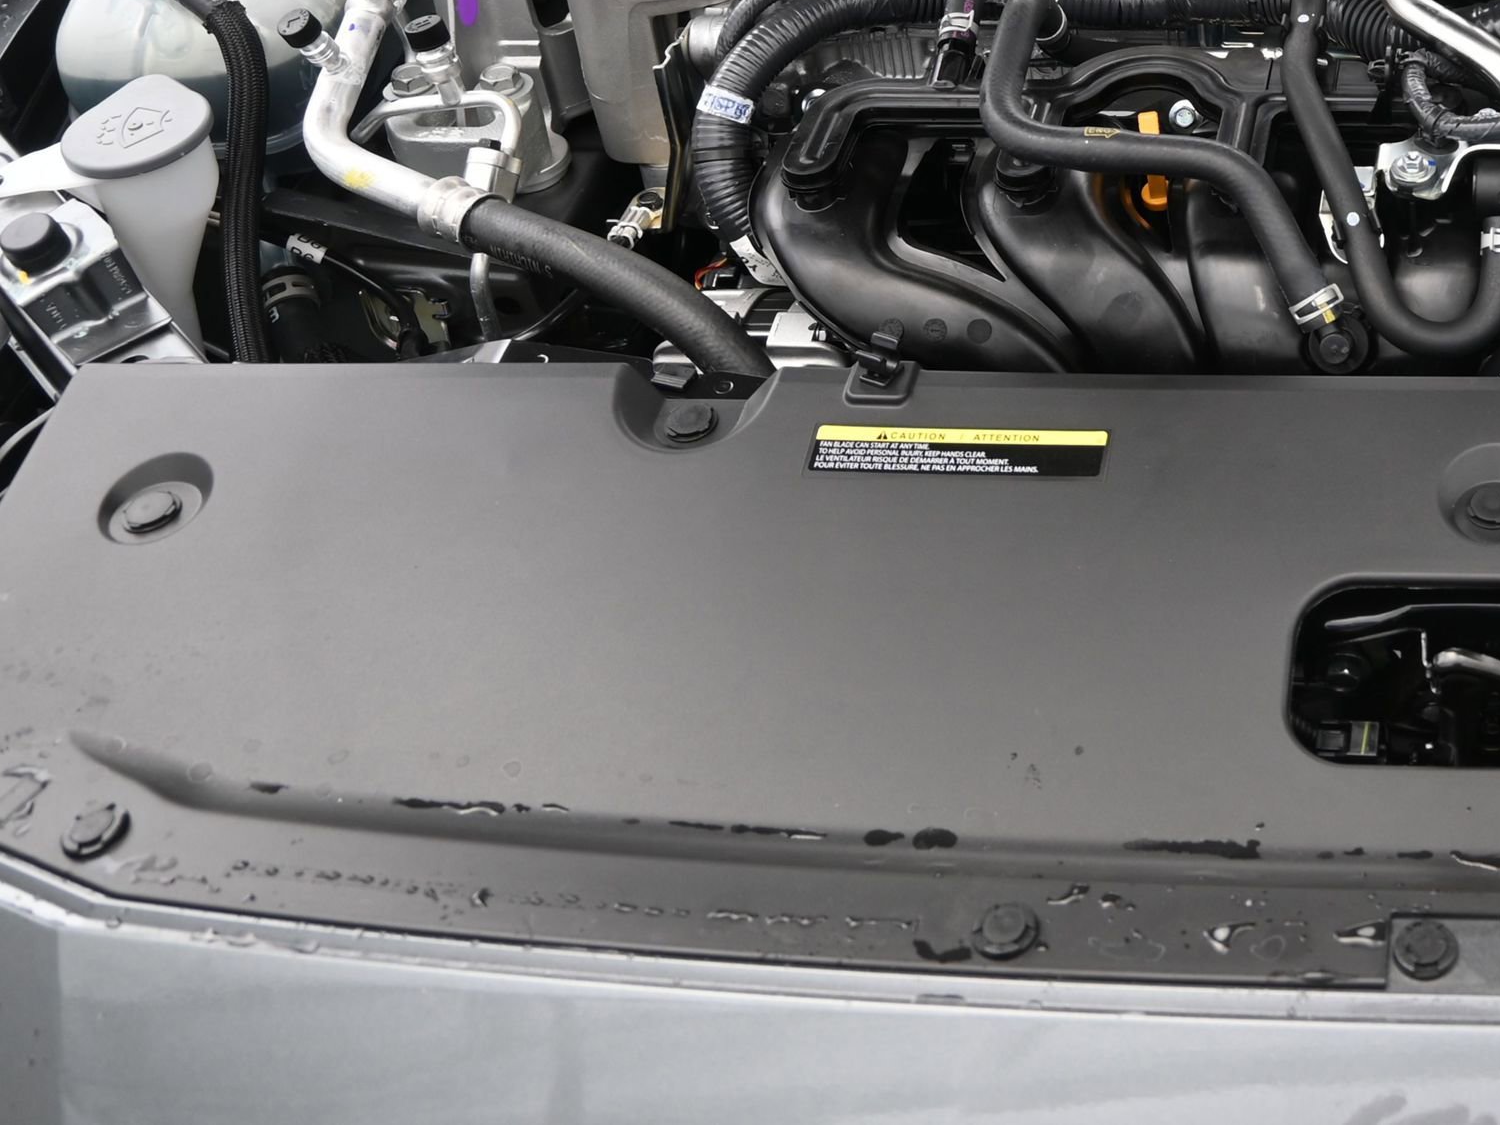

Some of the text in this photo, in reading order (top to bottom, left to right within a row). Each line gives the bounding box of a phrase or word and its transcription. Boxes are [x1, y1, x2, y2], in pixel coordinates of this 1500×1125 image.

[890, 431, 946, 441] CAUTION
[973, 434, 1040, 442] ATTENTION
[825, 455, 872, 463] VENTILATEUR
[872, 456, 898, 464] RISQUE
[957, 465, 1000, 473] APPROCHER
